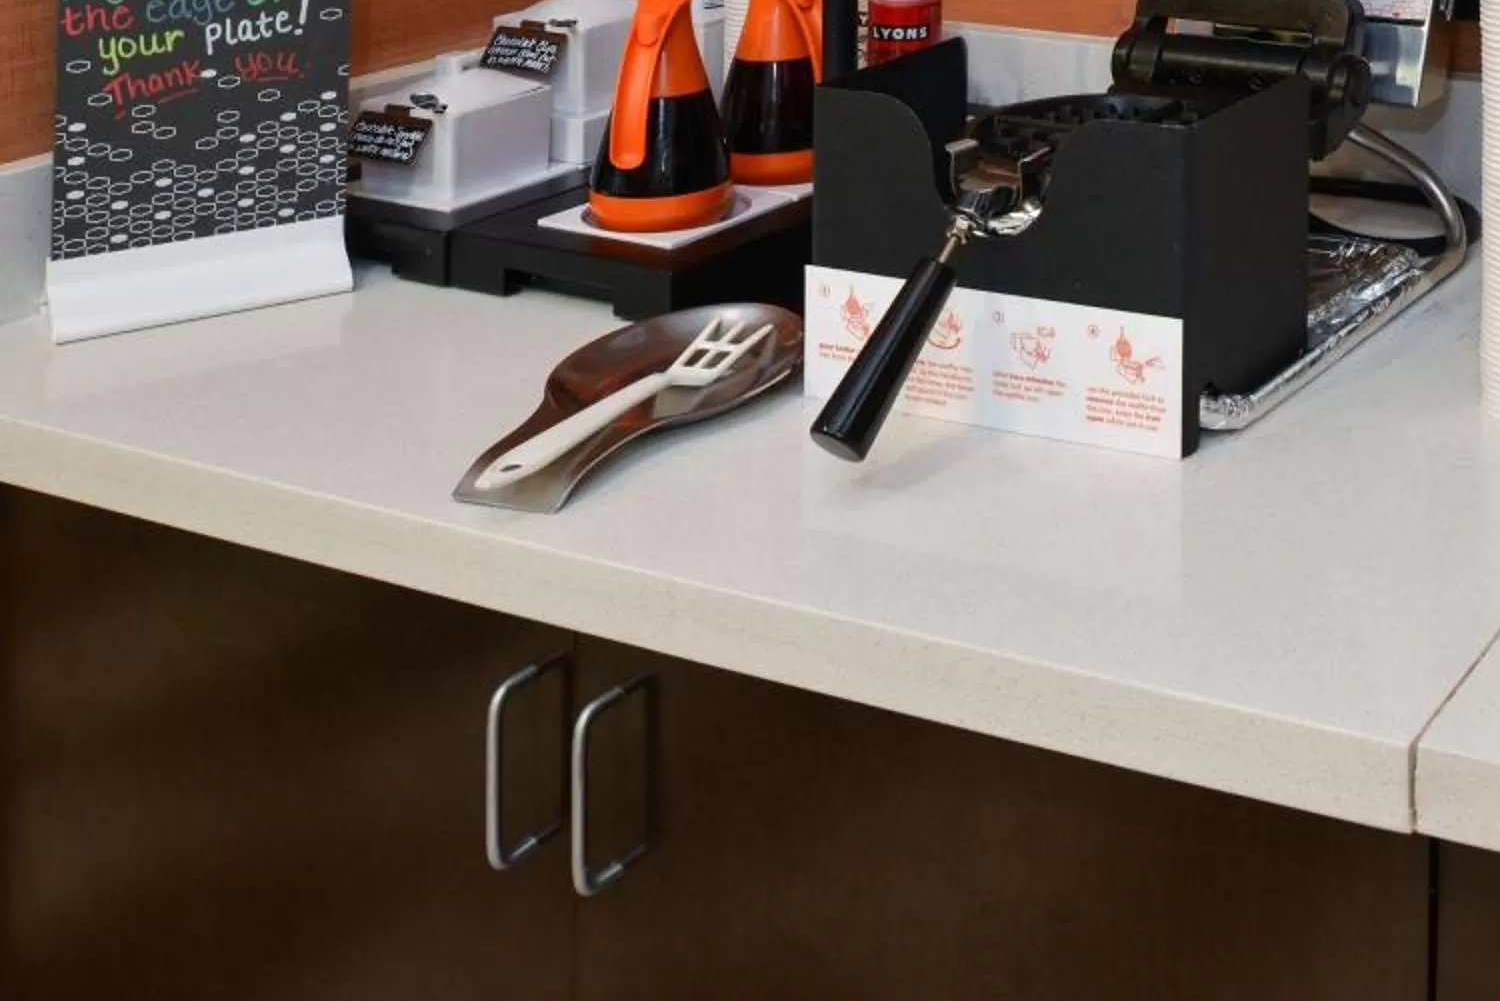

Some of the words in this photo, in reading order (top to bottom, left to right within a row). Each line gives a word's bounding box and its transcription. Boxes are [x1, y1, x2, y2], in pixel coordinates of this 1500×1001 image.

[61, 3, 136, 37] the
[871, 25, 929, 40] LYONS
[99, 28, 185, 76] your
[105, 58, 202, 106] Thank
